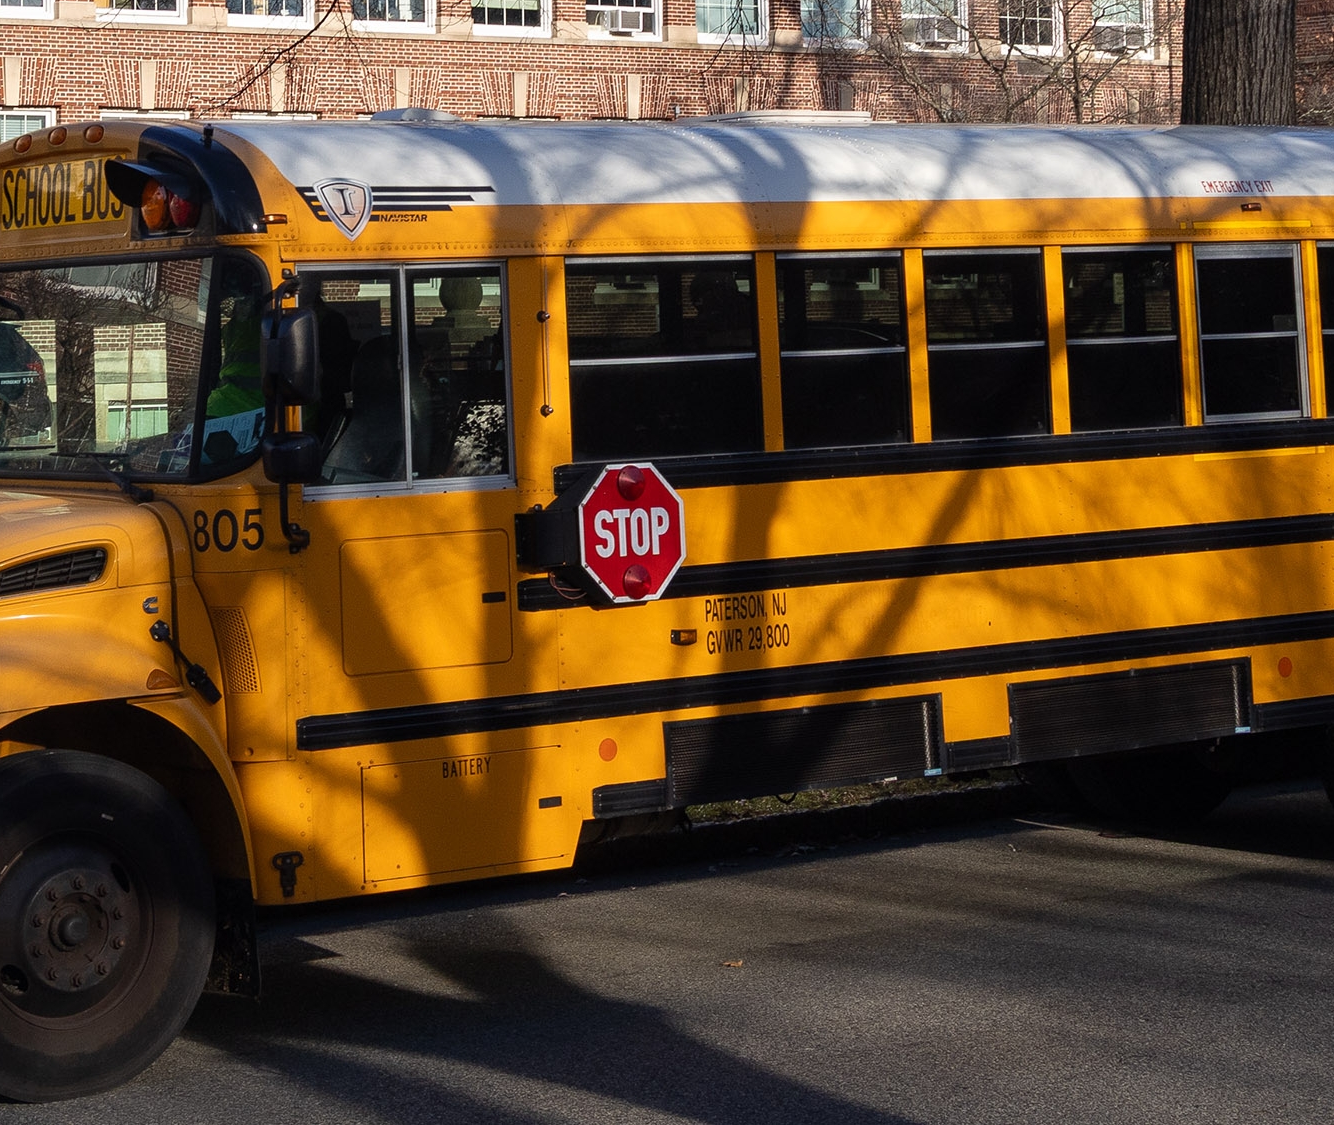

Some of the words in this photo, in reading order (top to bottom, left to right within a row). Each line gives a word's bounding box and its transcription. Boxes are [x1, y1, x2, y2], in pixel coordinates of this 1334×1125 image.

[2, 161, 76, 230] SCHOOL
[1201, 180, 1254, 193] EMERGENCY
[1254, 180, 1274, 193] EXIT
[380, 214, 428, 223] NAVISTAR
[193, 508, 265, 553] 805
[593, 506, 670, 559] STOP
[705, 593, 768, 623] PATERSON,
[772, 592, 787, 617] NJ
[706, 628, 744, 655] GVWR
[748, 623, 790, 654] 29,800
[442, 756, 492, 779] BATTERY
